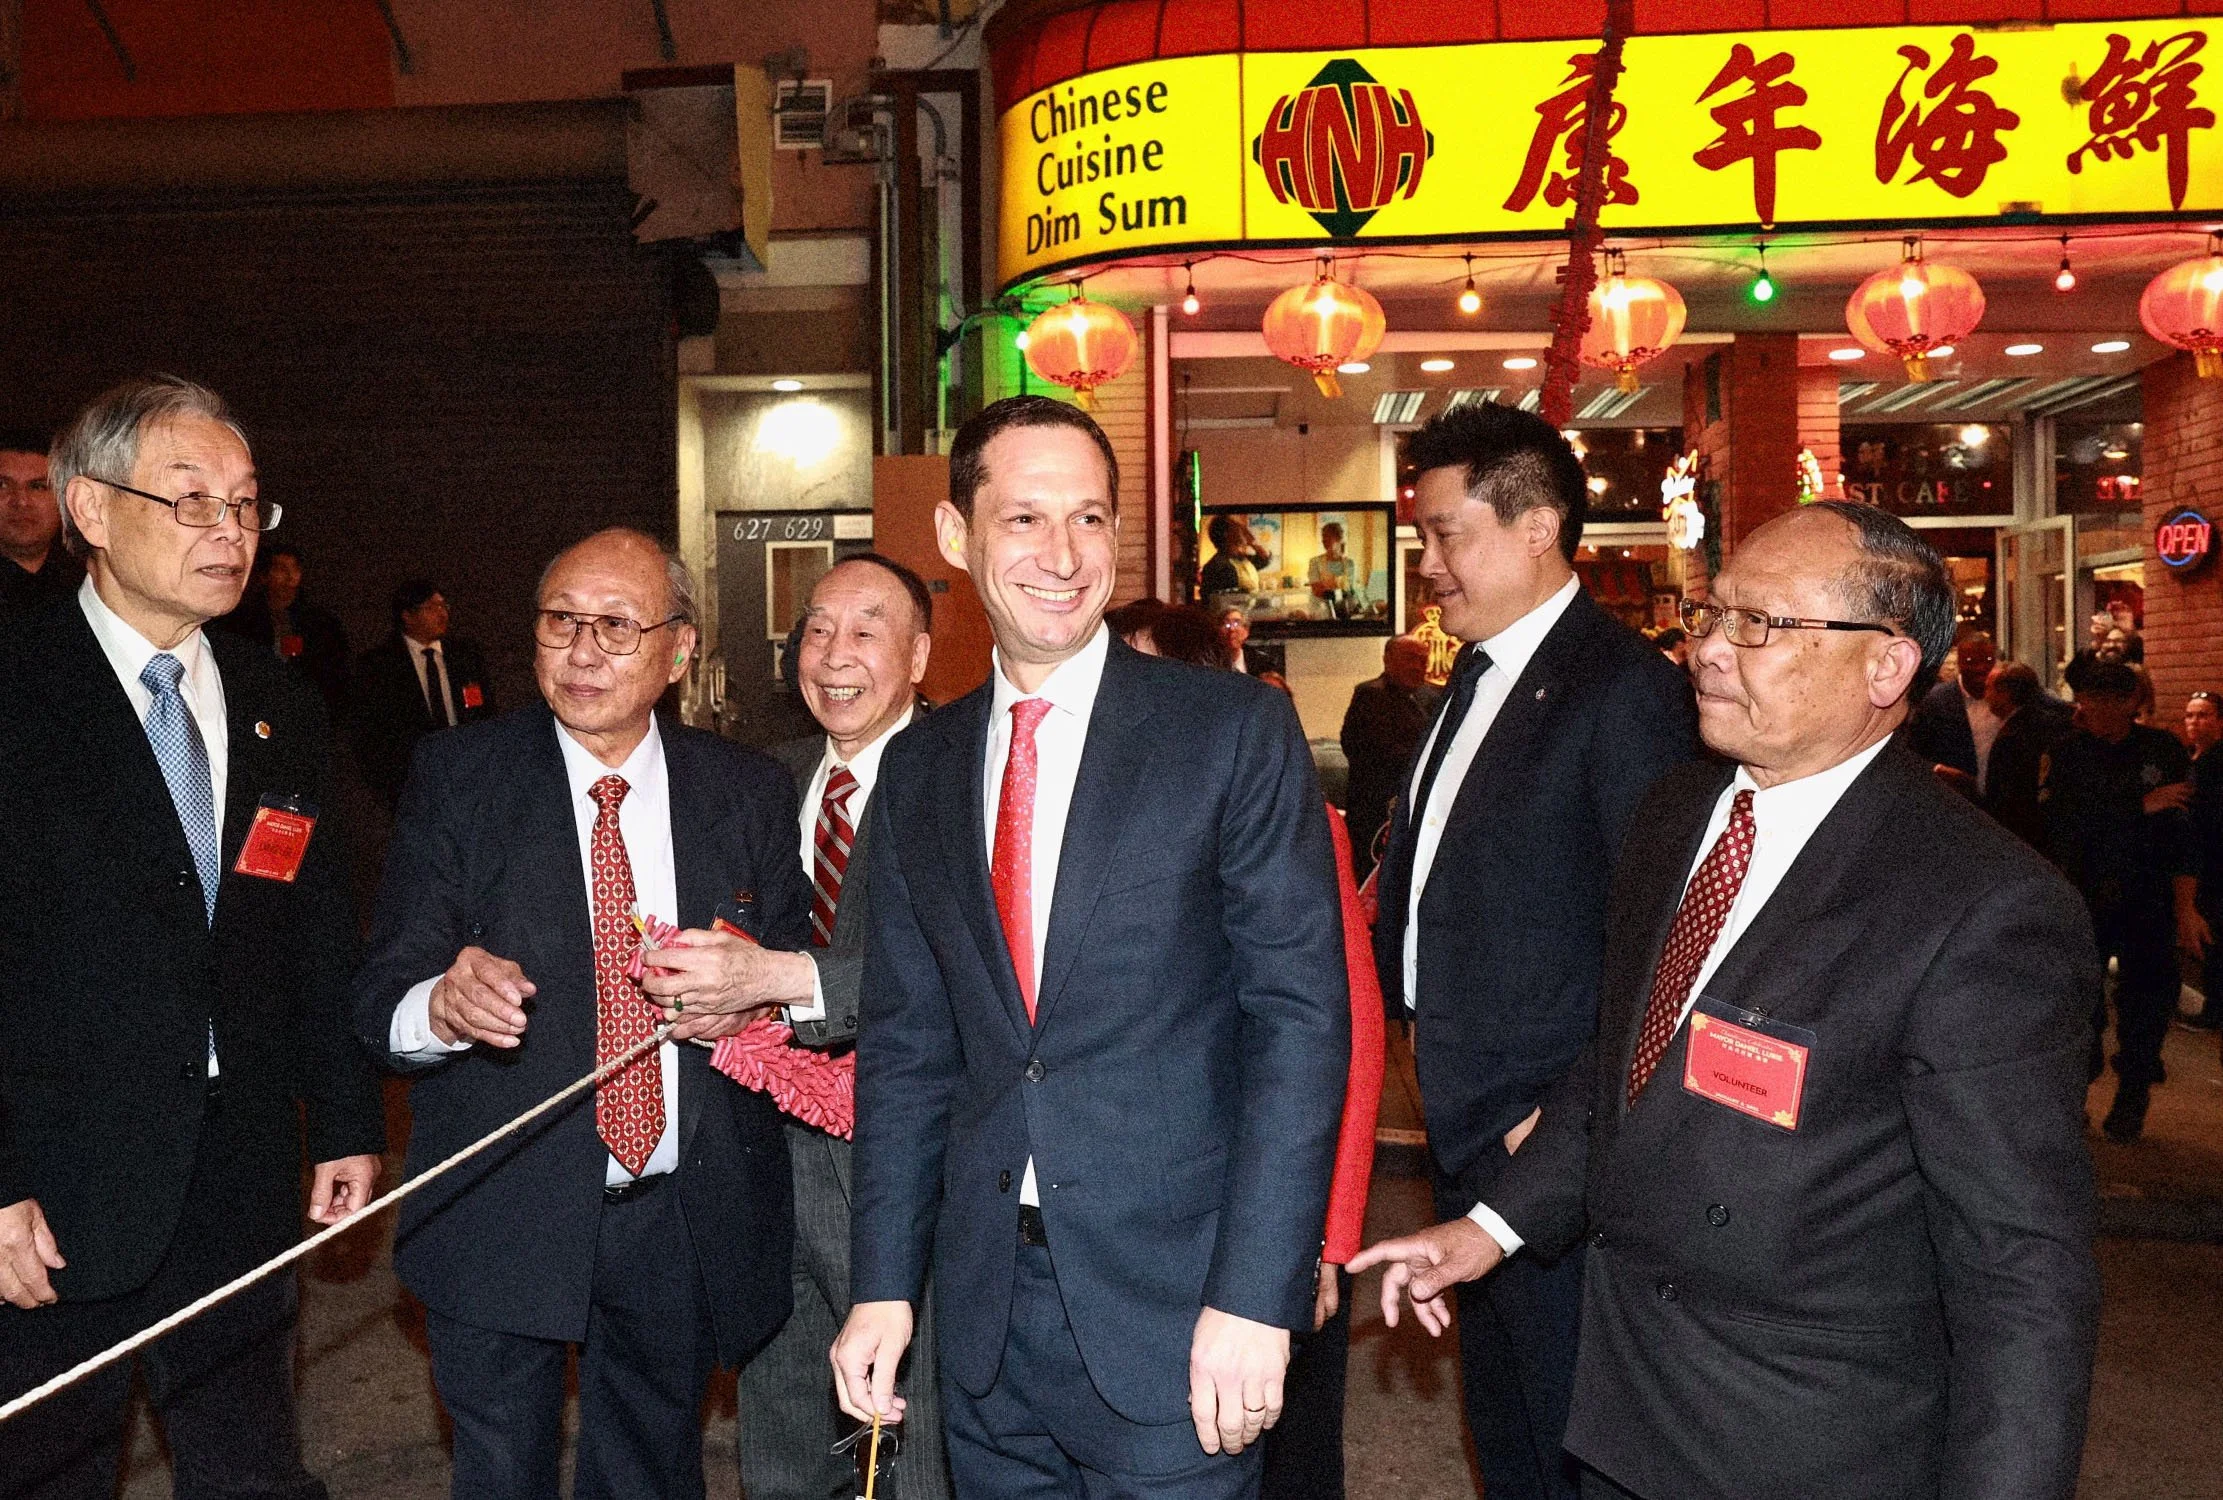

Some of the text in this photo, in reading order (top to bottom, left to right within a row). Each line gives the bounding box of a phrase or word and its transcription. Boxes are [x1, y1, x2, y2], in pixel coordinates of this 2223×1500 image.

[1031, 81, 1168, 144] Chinese
[1503, 30, 2216, 224] 康年海鮮
[1037, 133, 1164, 196] Cuisine
[1259, 82, 1429, 212] HNH
[1026, 192, 1187, 256] Dim Sum
[1848, 483, 1884, 505] ST
[733, 518, 772, 541] 627
[784, 517, 824, 540] 629
[2157, 523, 2211, 555] OPEN
[1712, 1070, 1768, 1097] VOLUNTEER
